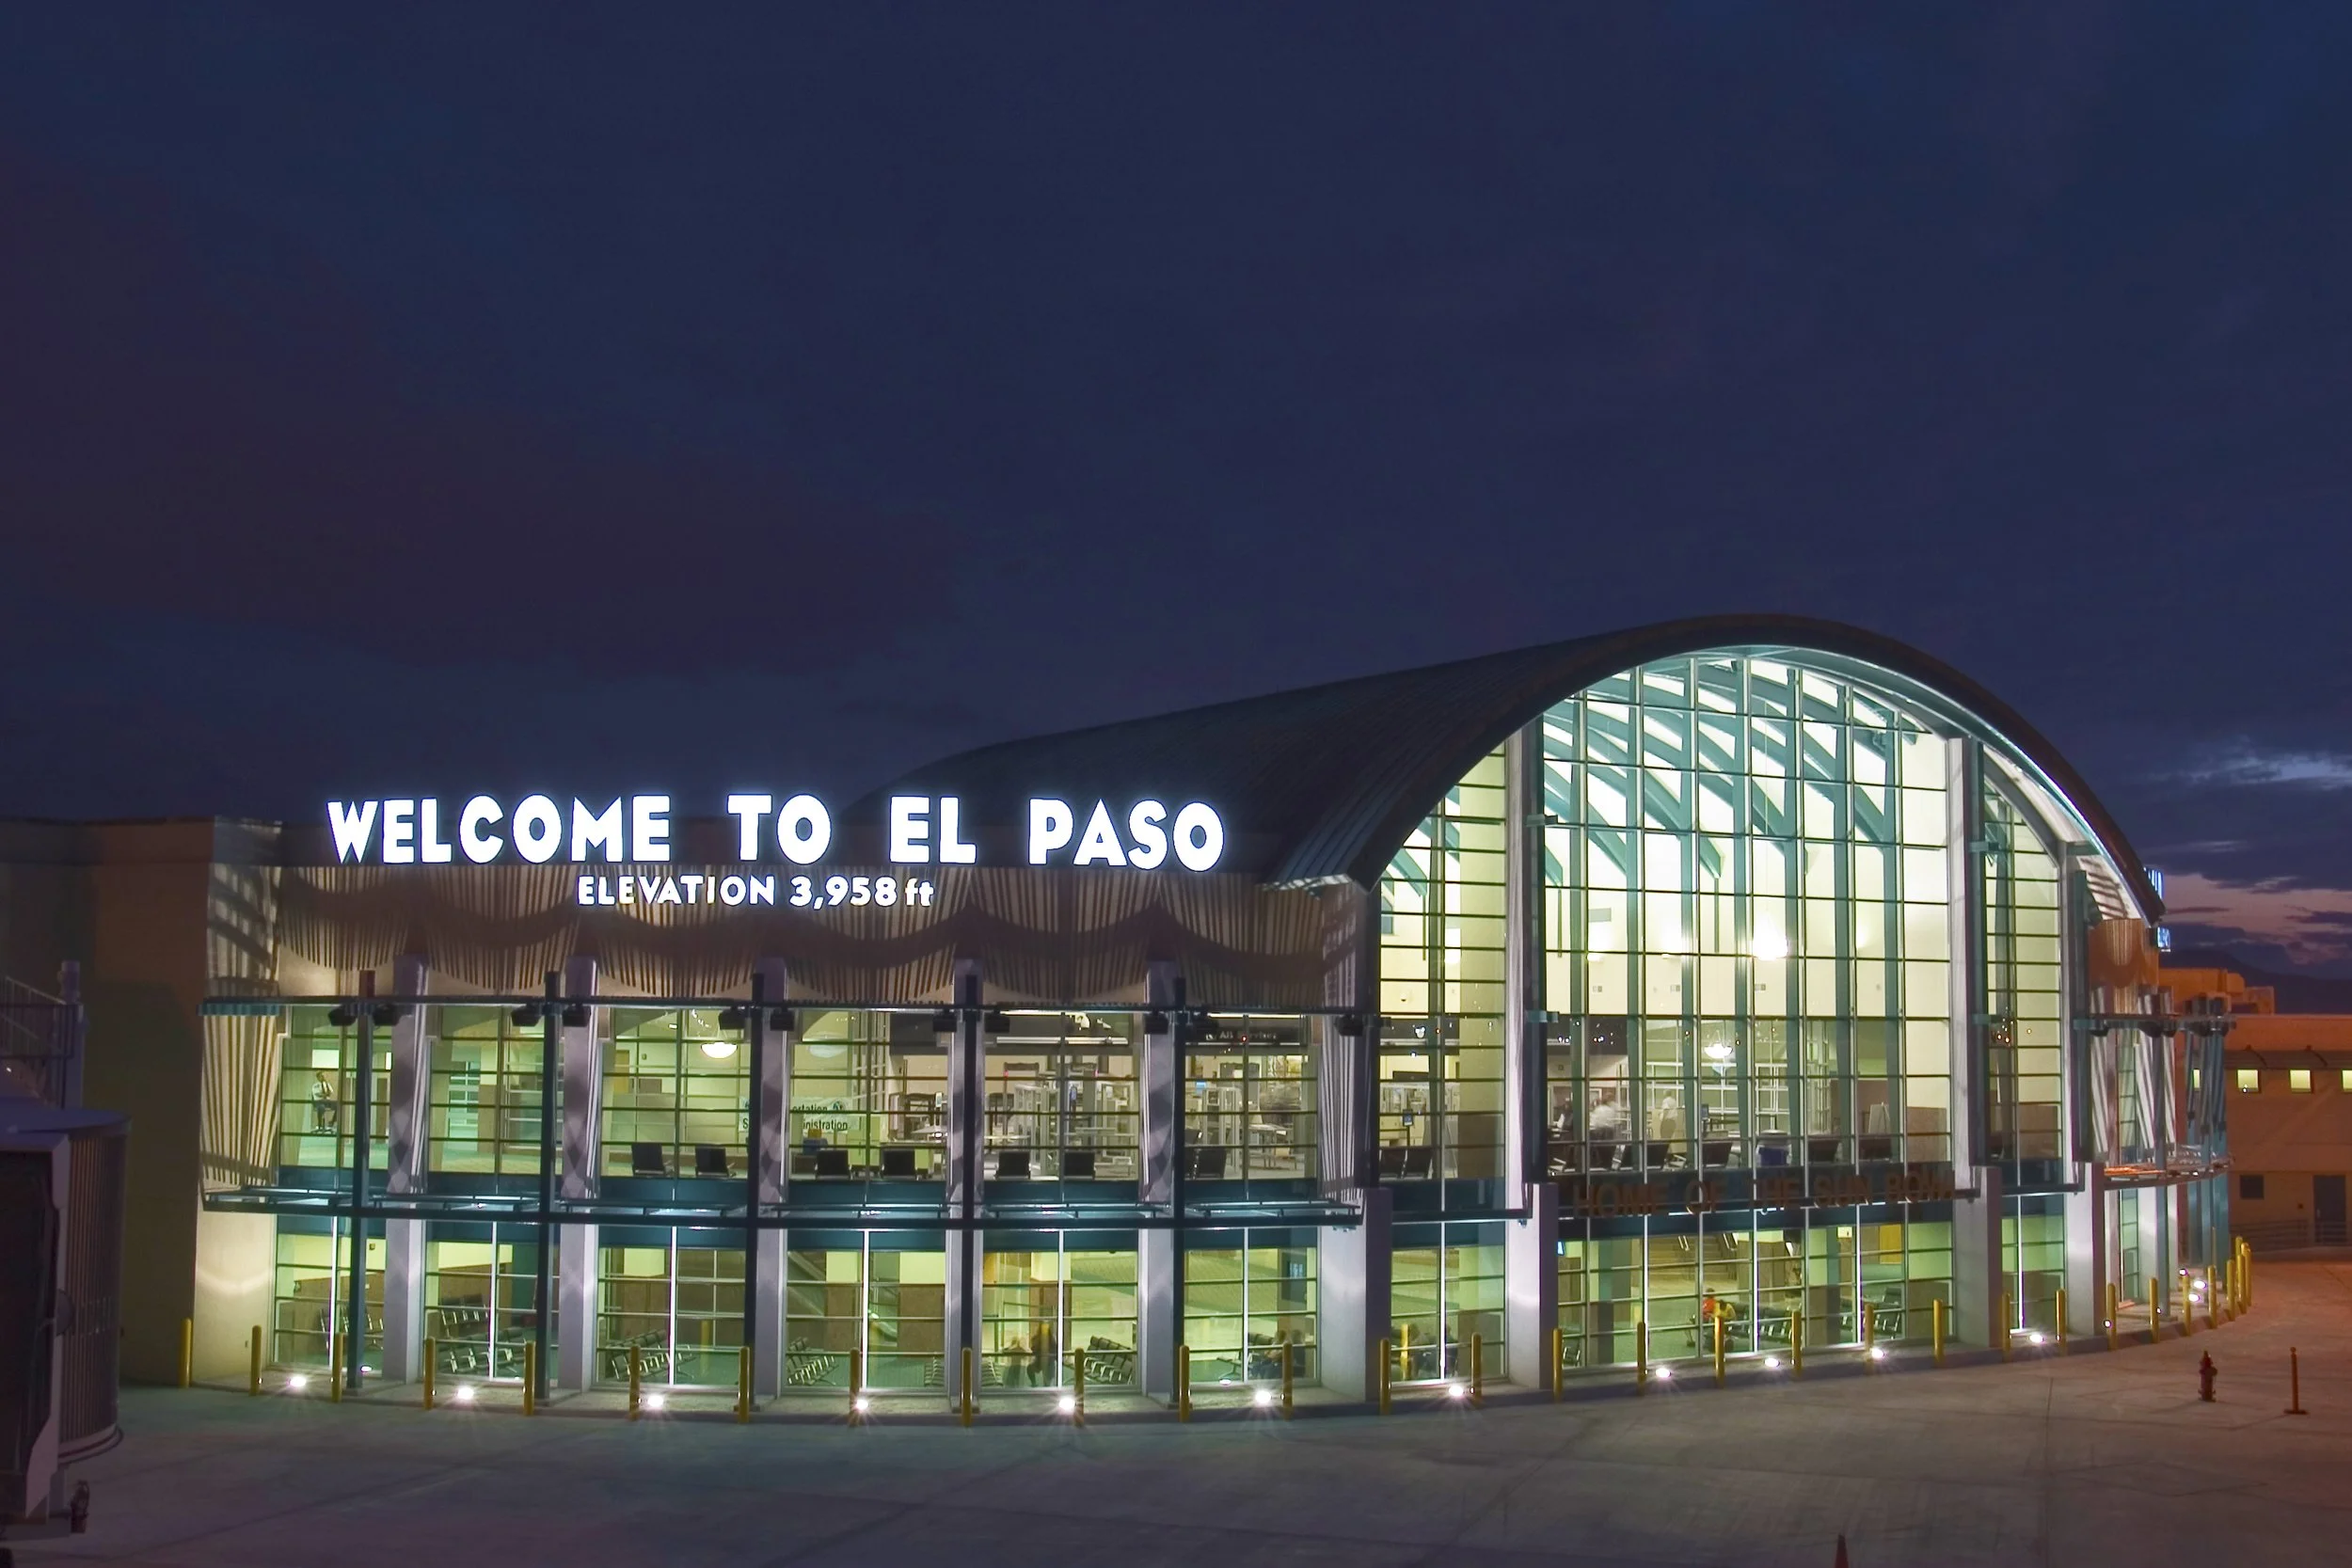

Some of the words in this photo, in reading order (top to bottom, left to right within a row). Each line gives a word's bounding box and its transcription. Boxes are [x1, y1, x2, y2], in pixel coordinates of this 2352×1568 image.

[327, 794, 670, 865] WELCOME
[727, 794, 832, 864] TO
[889, 796, 977, 864] EL
[1029, 797, 1224, 872] PASO
[577, 874, 774, 906] ELEVATION
[789, 876, 898, 911] 3,958
[904, 877, 935, 907] ft
[1572, 1180, 1668, 1219] HOME
[1684, 1179, 1726, 1215] OF
[1813, 1173, 1872, 1208] SUN
